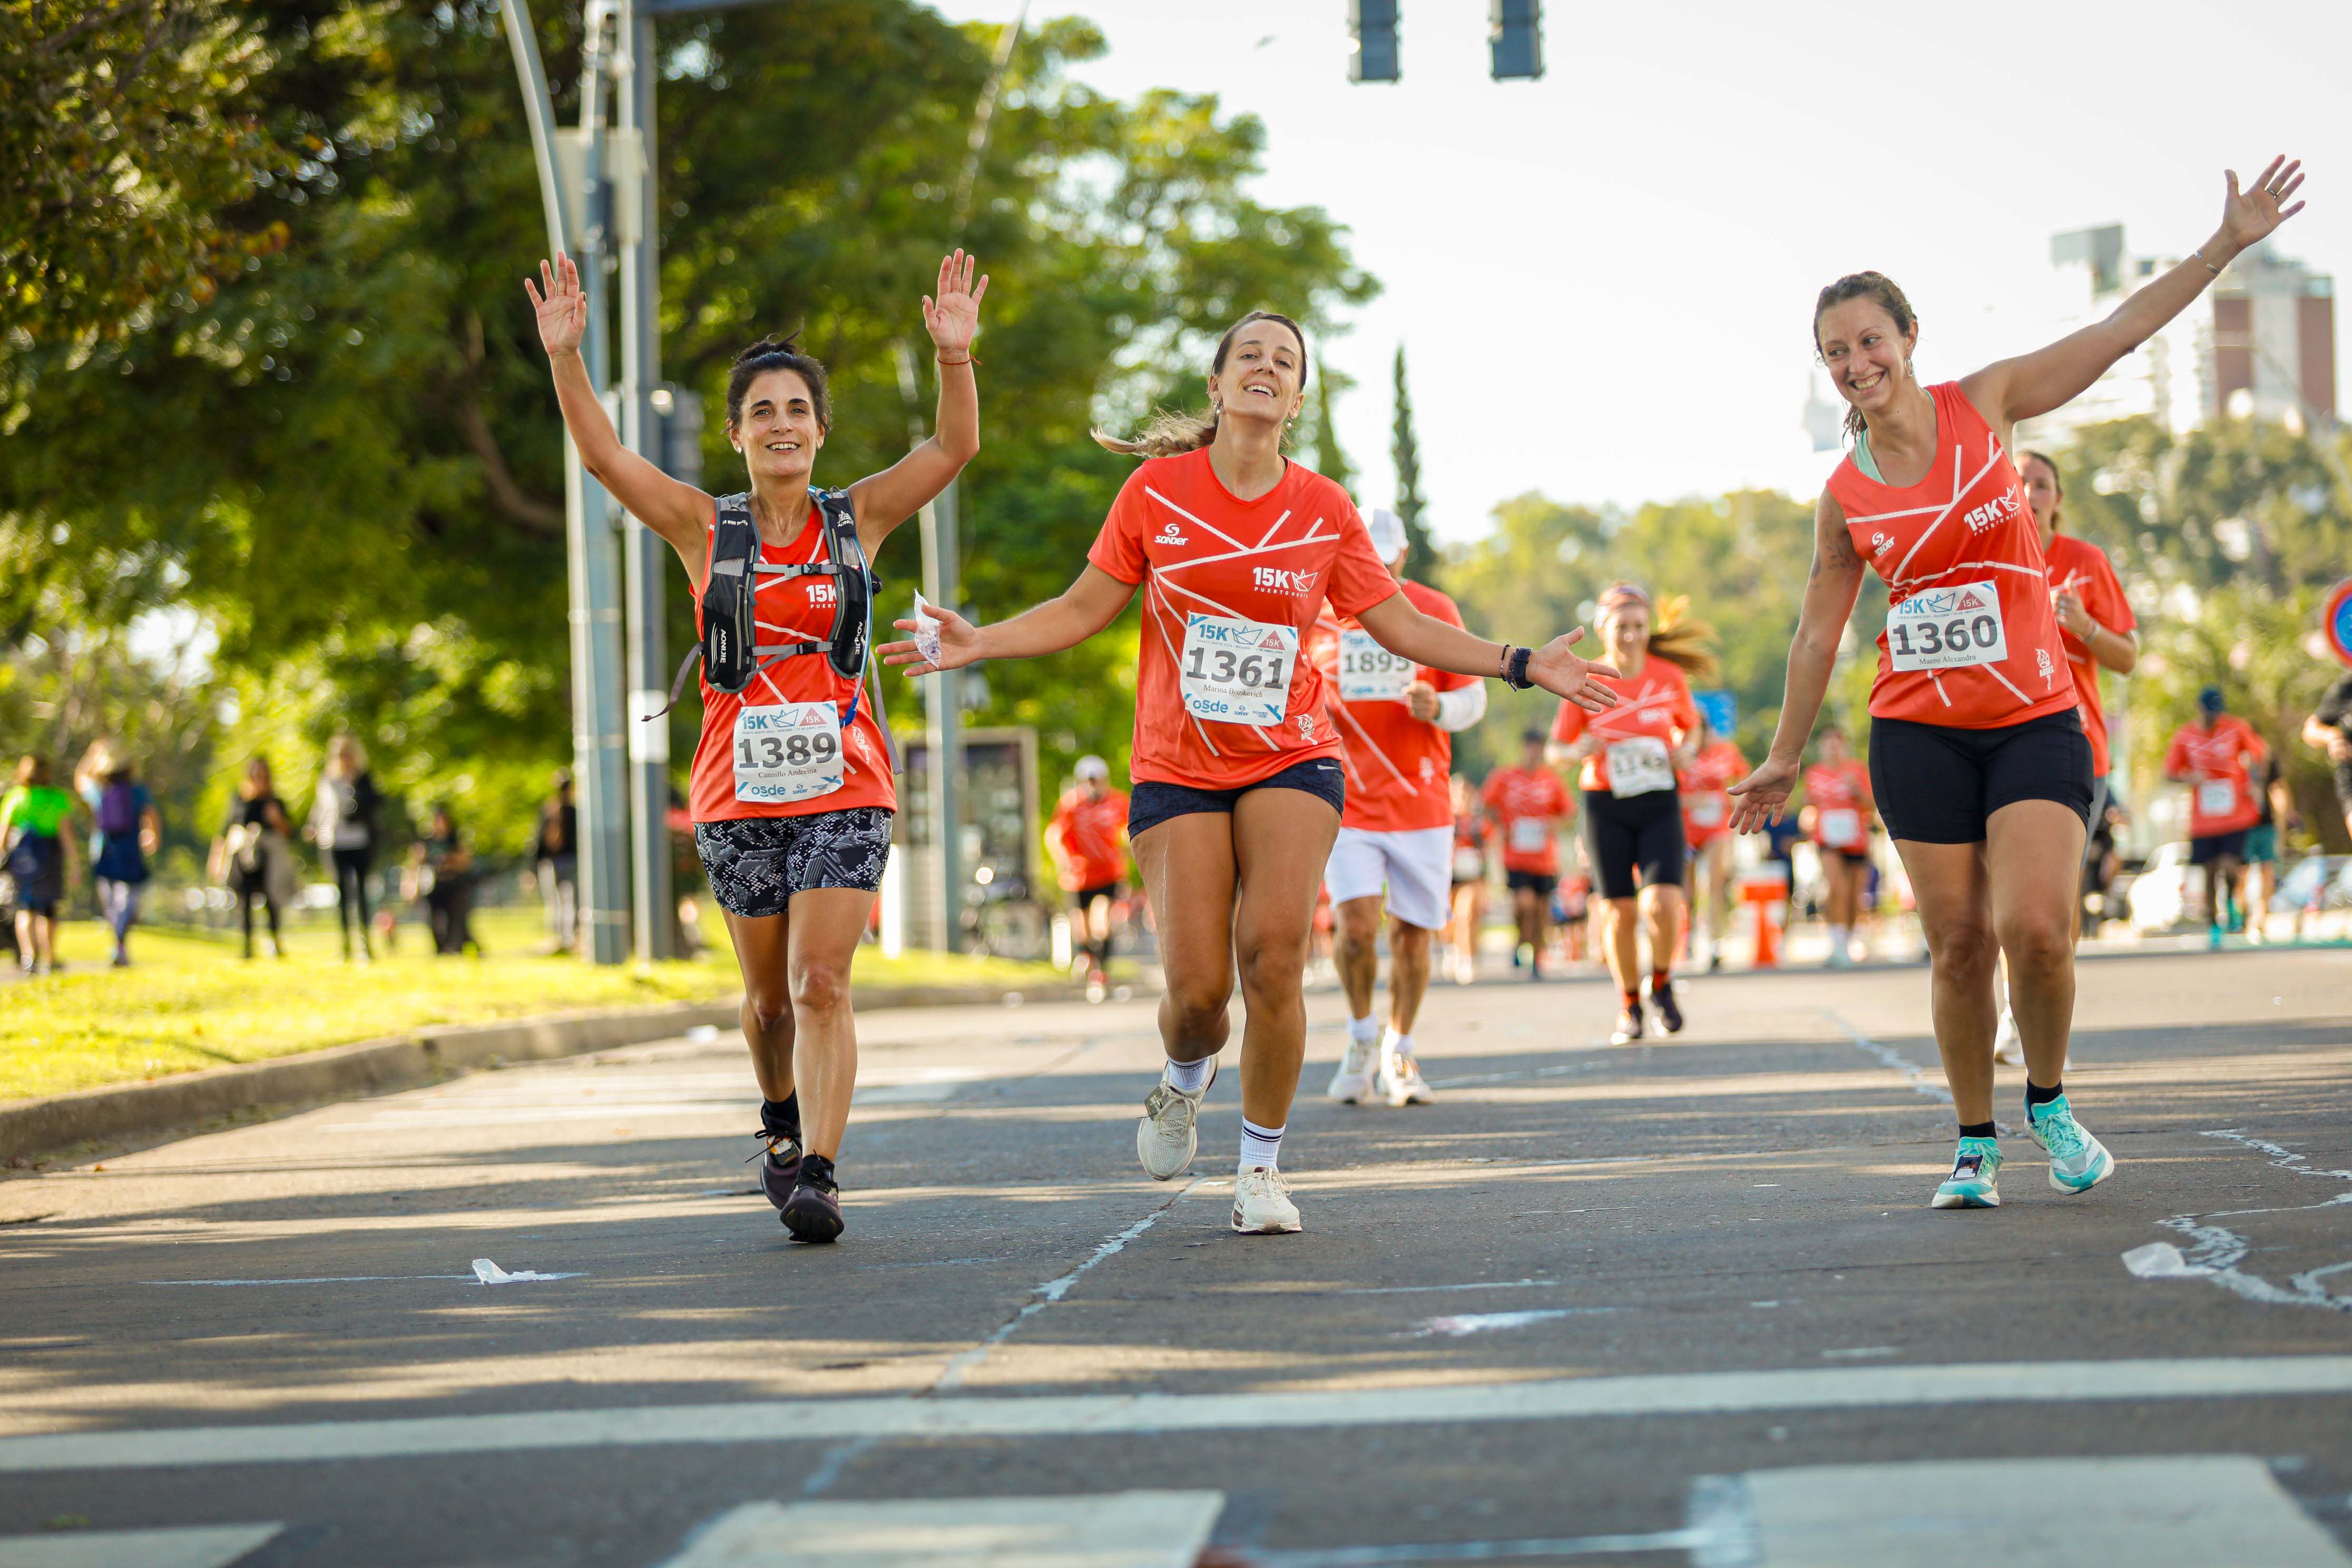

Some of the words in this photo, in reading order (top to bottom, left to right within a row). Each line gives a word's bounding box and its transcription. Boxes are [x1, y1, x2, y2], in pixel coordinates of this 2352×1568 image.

[1964, 499, 2003, 531] 15K
[1974, 518, 2004, 536] PUERTO
[1253, 567, 1290, 589] 15K
[1255, 586, 1289, 595] PUERTO
[1899, 599, 1924, 614] 15K
[1962, 599, 1978, 607] 15K
[1199, 624, 1229, 641] 15K
[1893, 615, 1998, 655] 1360
[1266, 639, 1279, 648] 15K
[1345, 652, 1409, 673] 1895
[1943, 654, 1976, 663] Alexandra
[1186, 646, 1283, 689] 1361
[1203, 684, 1227, 694] Marina
[1229, 688, 1263, 698] Bozikovich
[1193, 700, 1229, 713] osde
[742, 714, 768, 730] 15K
[738, 732, 836, 769] 1389
[751, 785, 786, 796] osde
